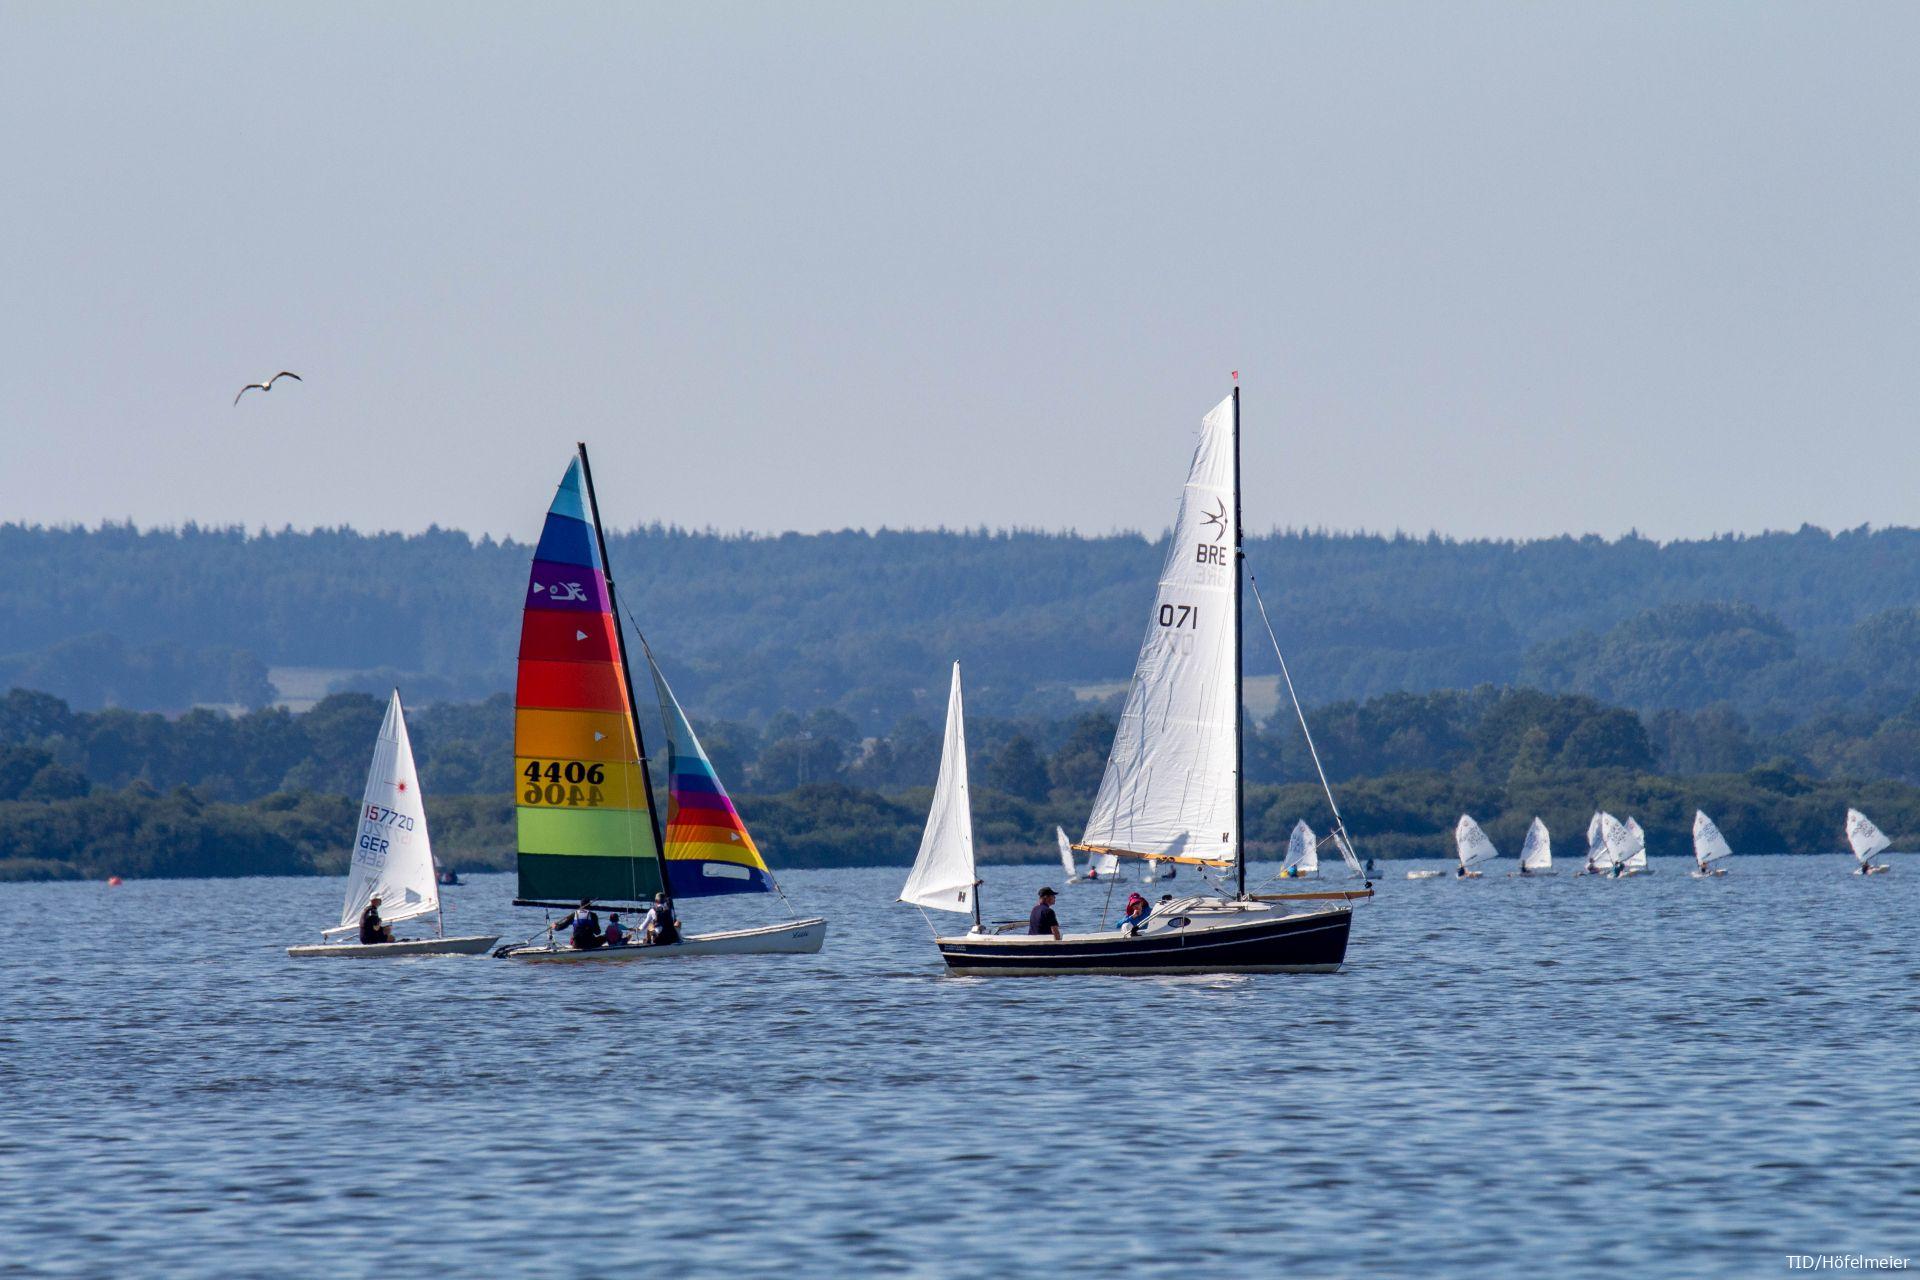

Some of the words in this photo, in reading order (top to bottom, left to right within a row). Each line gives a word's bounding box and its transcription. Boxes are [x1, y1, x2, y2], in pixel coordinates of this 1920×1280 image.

[1196, 543, 1227, 566] BRE
[1159, 604, 1198, 630] 071
[523, 761, 605, 785] 4406
[364, 805, 415, 832] 157720
[360, 834, 390, 855] GER
